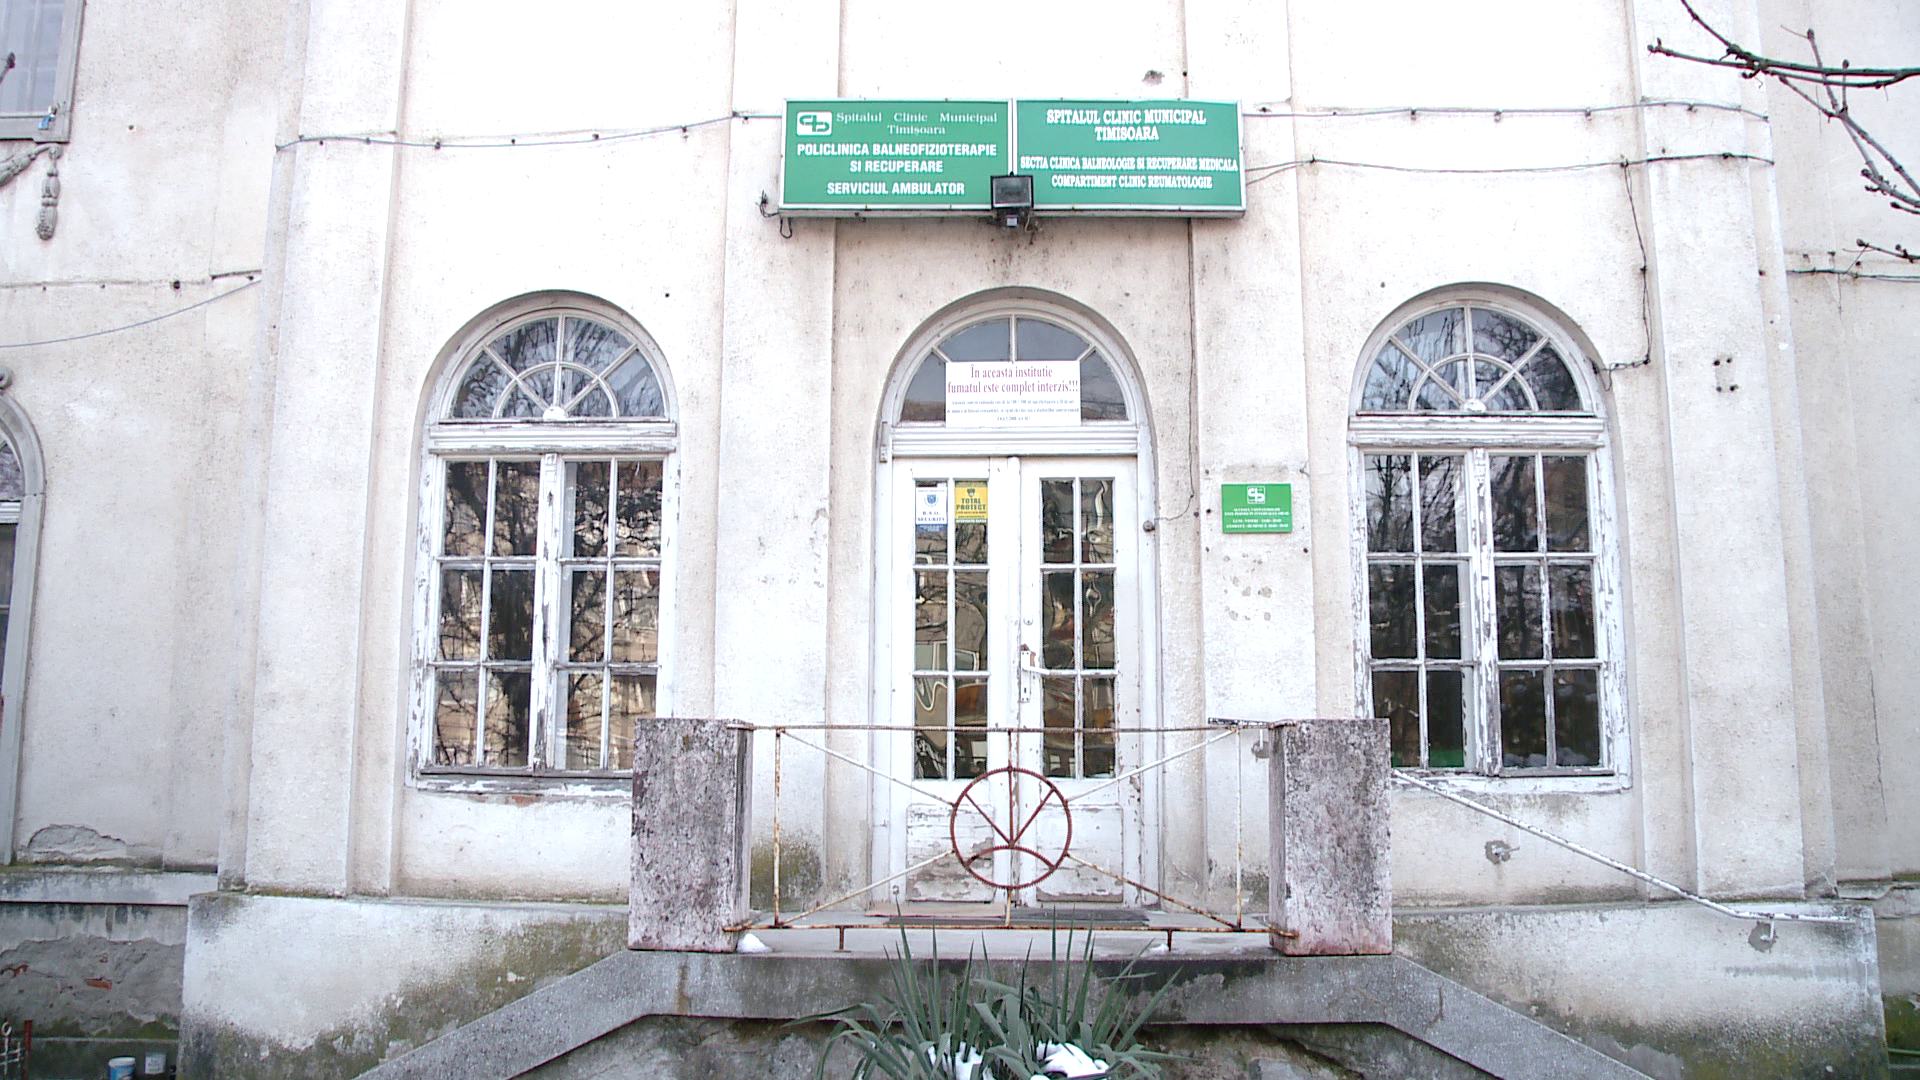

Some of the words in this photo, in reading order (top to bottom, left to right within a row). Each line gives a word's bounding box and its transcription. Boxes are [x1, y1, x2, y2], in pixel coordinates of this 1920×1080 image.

[836, 112, 882, 122] Spitalul
[894, 112, 928, 122] Clinic
[939, 113, 998, 124] Municipal
[1046, 109, 1100, 124] SPITALUL
[1103, 109, 1141, 124] CLINIC
[1144, 110, 1206, 125] MUNICIPAL
[1094, 126, 1159, 141] TIMISOARA
[797, 143, 869, 156] POLICLINICA
[872, 143, 997, 156] BALNEOFIZIOTERAPIE
[849, 161, 862, 172] SI
[865, 160, 943, 173] RECUPERARE
[1020, 156, 1048, 169] SECTIA
[1050, 156, 1080, 169] CLINICA
[1082, 157, 1134, 170] BALNEOLOGIE
[1137, 157, 1145, 169] SI
[1146, 157, 1197, 170] RECUPERARE
[1199, 158, 1238, 171] MEDICALA
[1051, 175, 1117, 188] COMPARTIMENT
[1118, 175, 1146, 188] CLINIC
[1148, 175, 1212, 188] REUMATOLOGIE
[827, 182, 888, 195] SERVICIUL
[892, 182, 965, 195] AMBULATOR
[947, 382, 981, 393] fumatul
[983, 384, 1000, 393] este
[1001, 381, 1035, 395] complet
